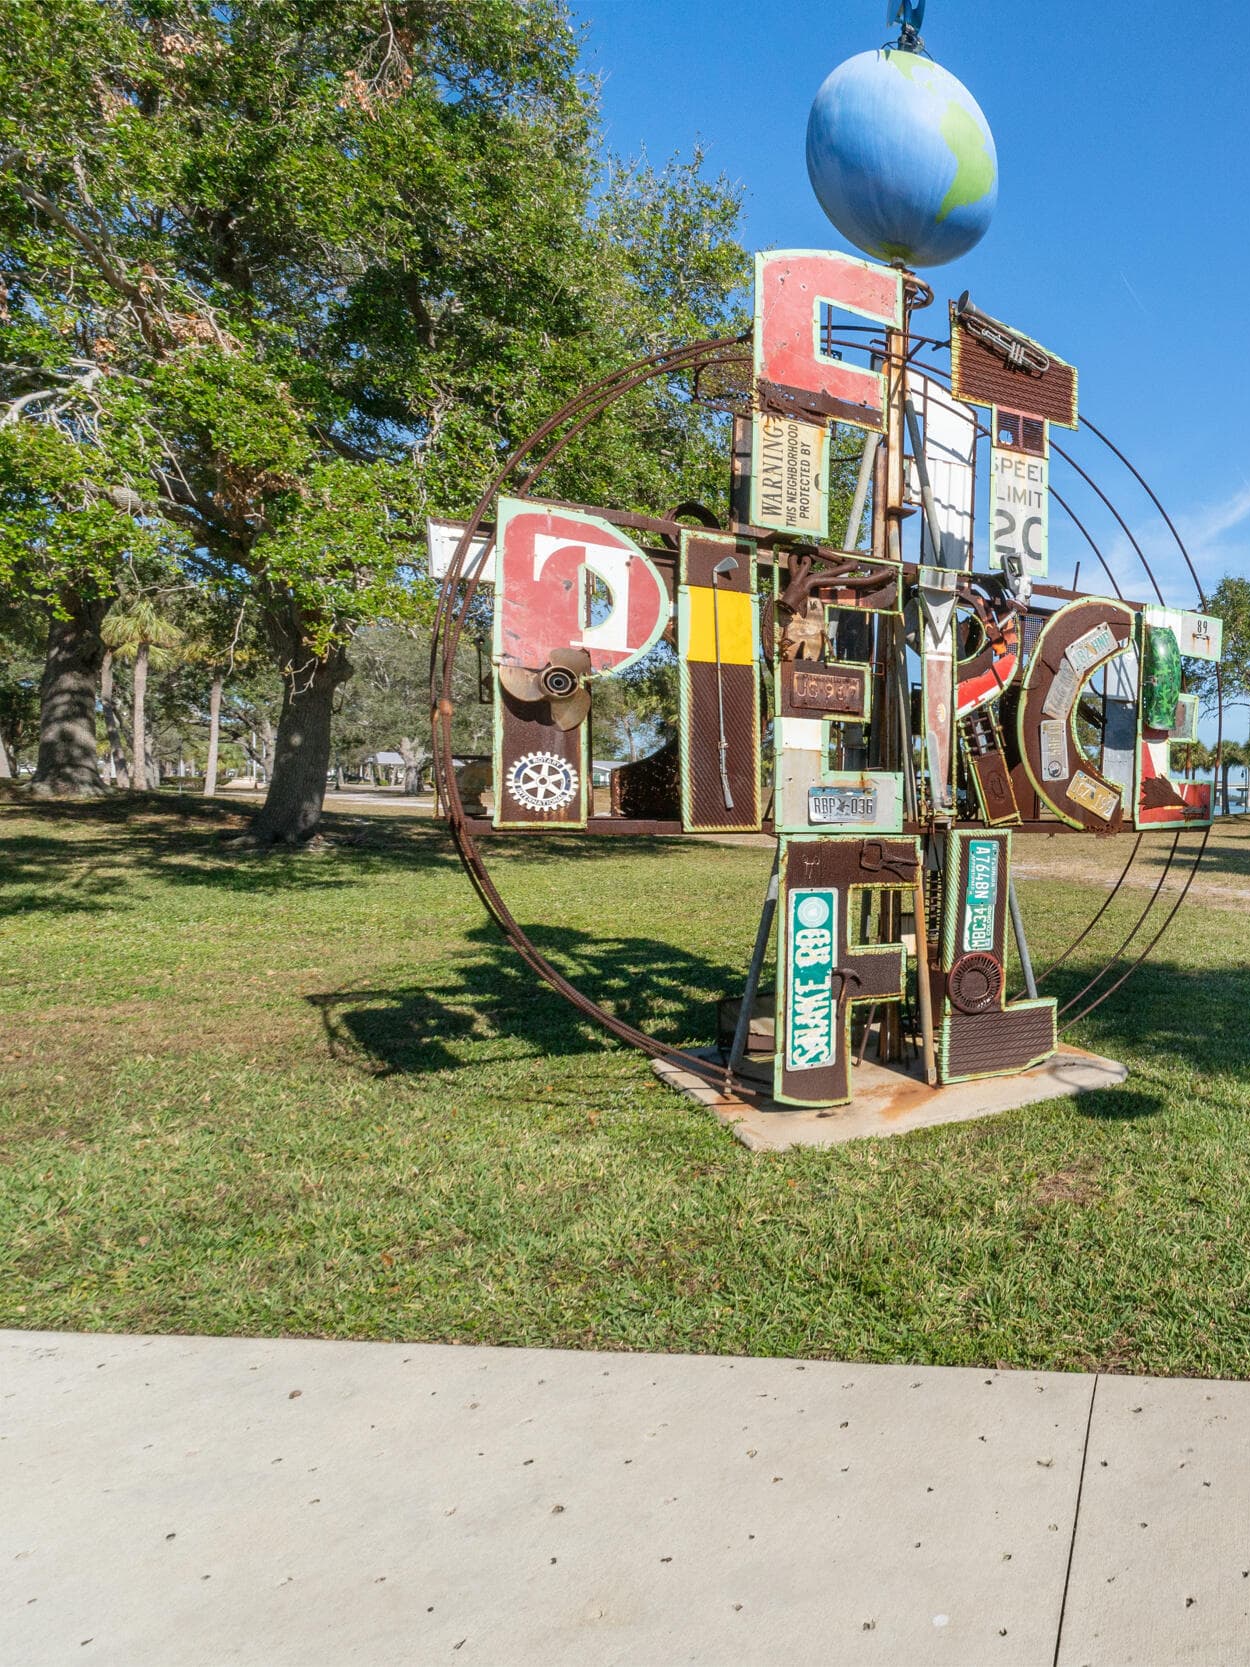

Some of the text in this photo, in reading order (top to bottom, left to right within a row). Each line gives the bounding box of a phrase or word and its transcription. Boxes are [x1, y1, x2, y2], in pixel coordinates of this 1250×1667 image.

[762, 425, 784, 517] WARNING
[786, 424, 799, 527] THIS NEIGHBORHOOD
[799, 442, 811, 519] PROTECTED BY
[994, 457, 1043, 483] PEE
[1197, 620, 1208, 634] 89
[975, 846, 991, 899] A7648N
[971, 905, 987, 948] MBC34
[792, 928, 832, 1067] SNAKE RD
